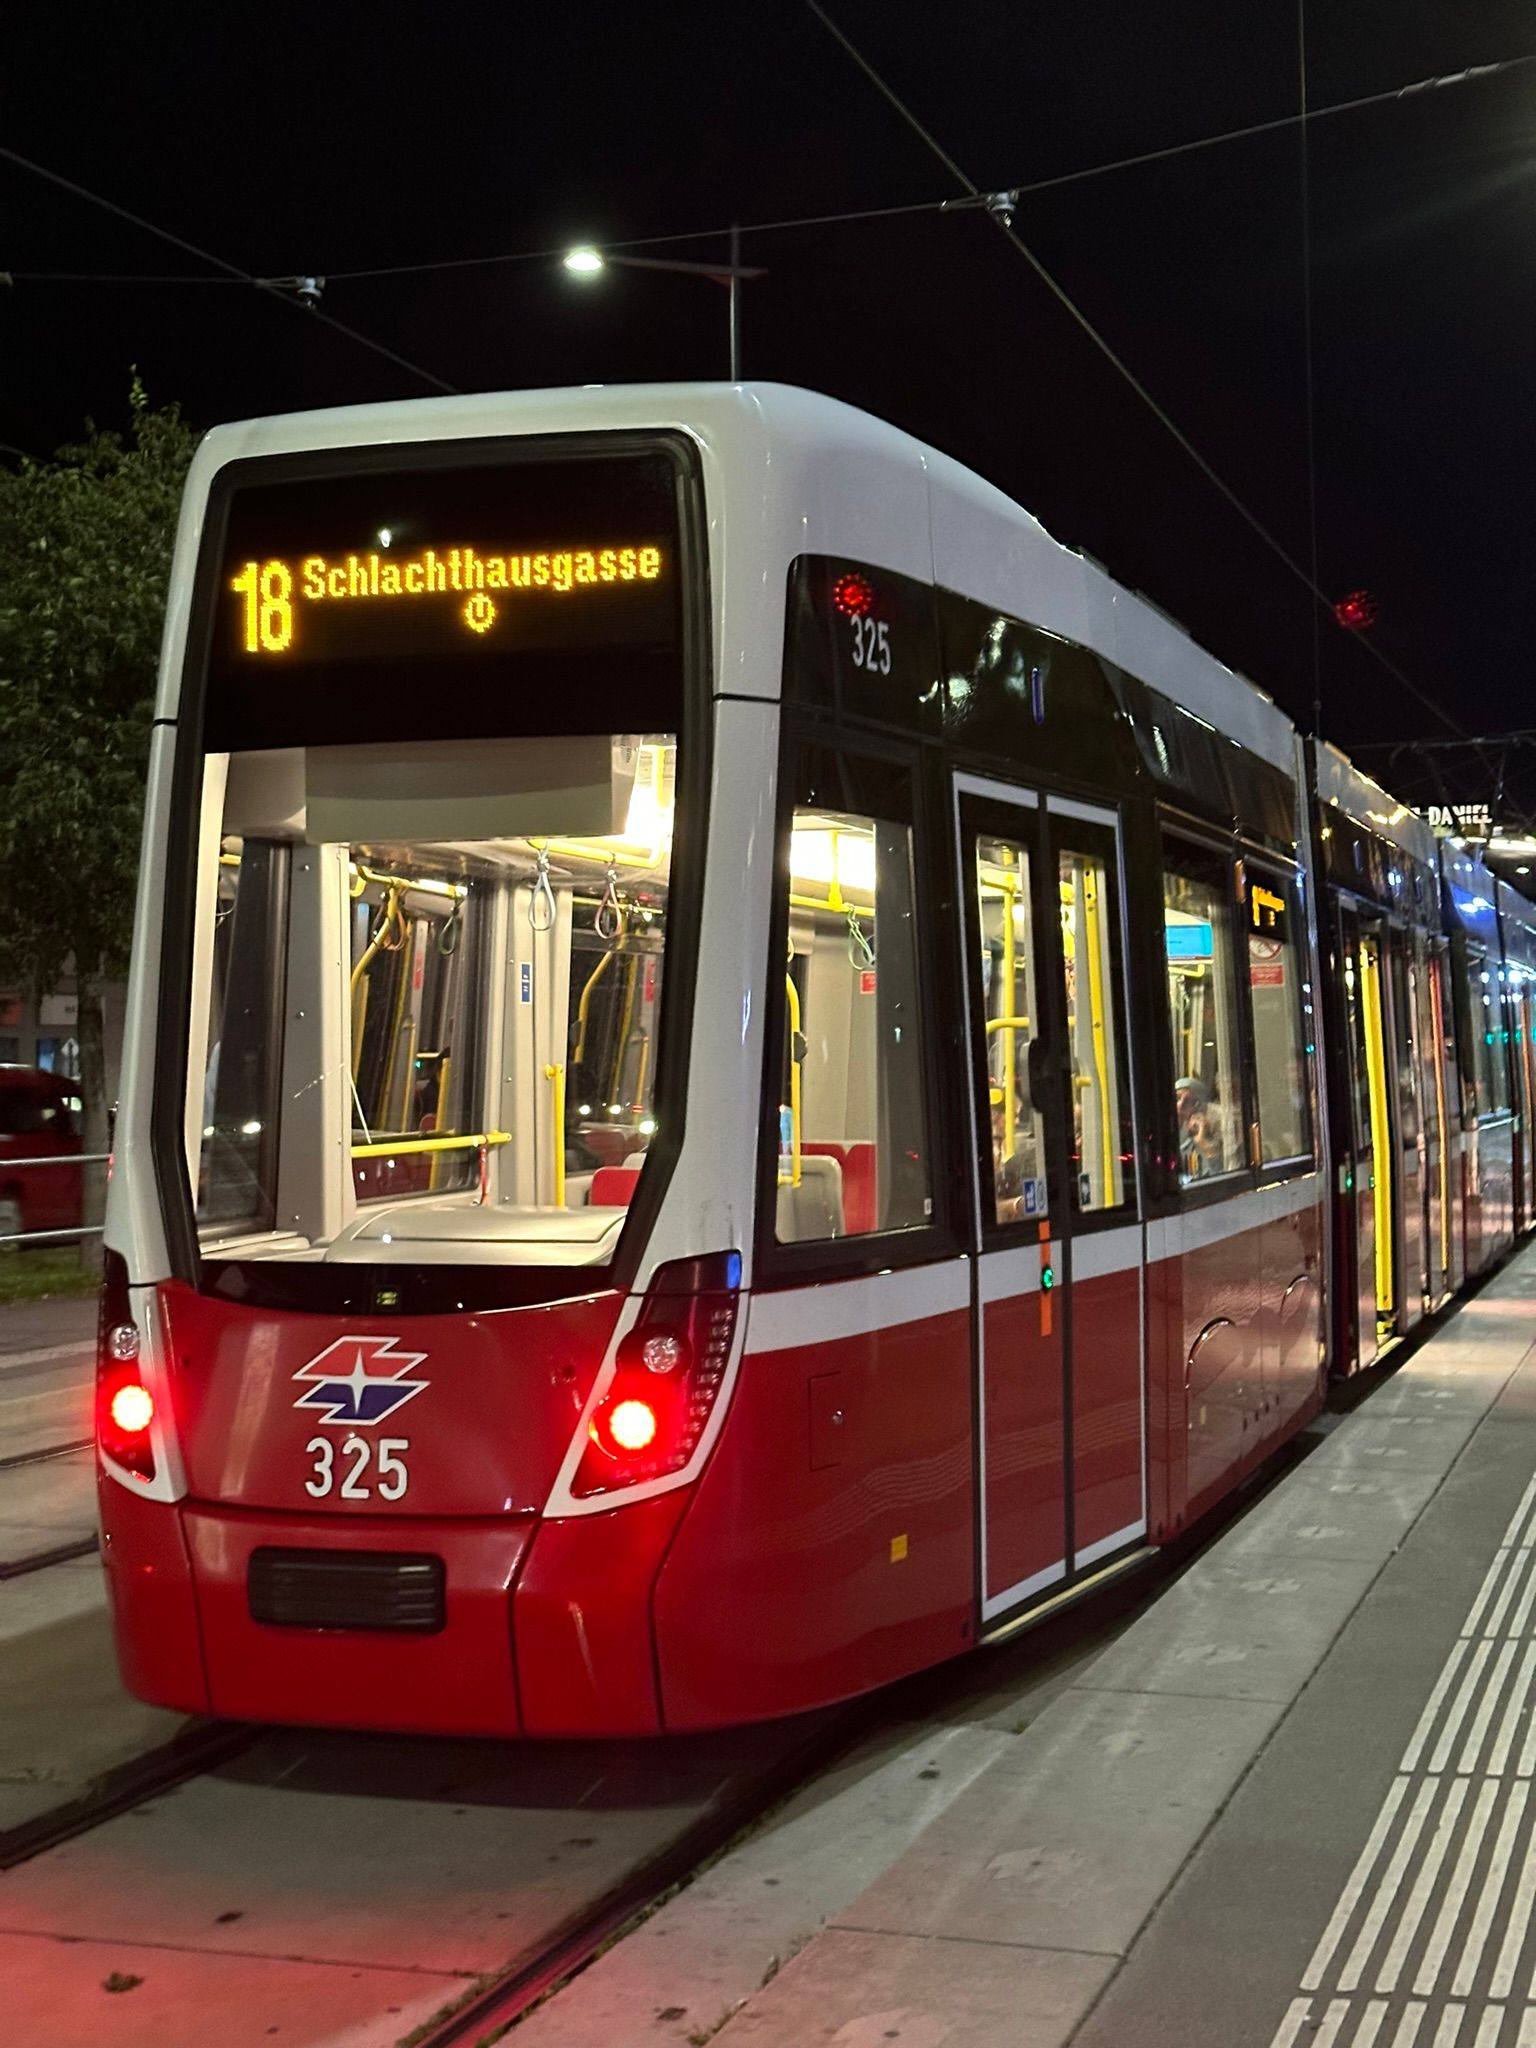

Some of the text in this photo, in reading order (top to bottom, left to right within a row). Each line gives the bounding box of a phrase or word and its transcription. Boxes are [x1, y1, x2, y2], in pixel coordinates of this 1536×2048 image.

[232, 547, 661, 652] 18 Schlachthausgasse
[851, 614, 891, 675] 325
[305, 1437, 408, 1499] 325
